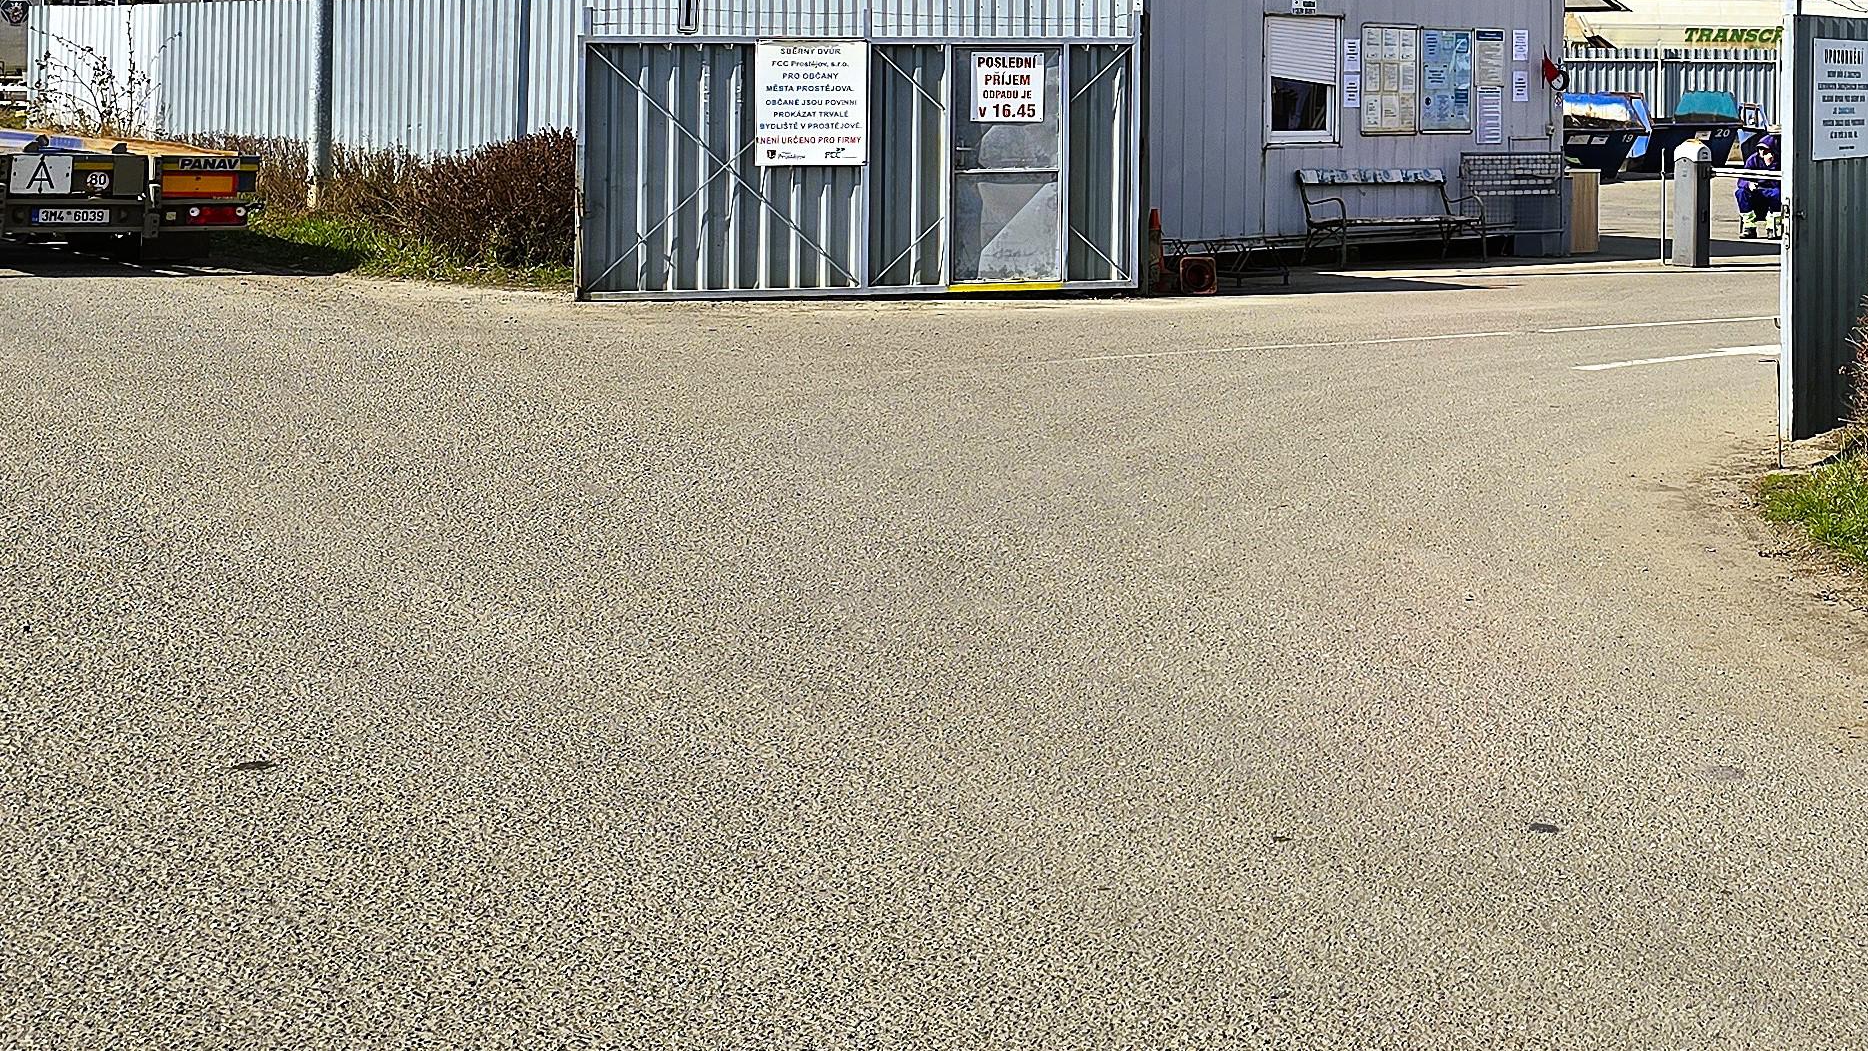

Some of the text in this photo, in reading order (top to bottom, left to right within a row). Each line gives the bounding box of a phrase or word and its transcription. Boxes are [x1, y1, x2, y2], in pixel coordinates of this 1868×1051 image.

[977, 54, 1037, 68] POSLEDNÍ
[802, 71, 839, 80] OBČANY
[984, 71, 1031, 86] PŘÍJEM
[765, 84, 795, 92] MĚSTA
[983, 90, 1032, 99] ODPADU JE
[765, 98, 800, 106] OBČANÉ
[819, 110, 849, 118] TRVALÉ
[993, 103, 1036, 118] 16.45
[759, 122, 798, 130] BYDLIŠTĚ
[1714, 128, 1730, 138] 20
[781, 135, 816, 144] URČENO
[818, 136, 835, 144] PRO
[837, 136, 862, 144] FIRMY
[1622, 134, 1633, 143] 19
[180, 158, 240, 170] PANAV
[25, 156, 55, 190] A
[90, 174, 107, 186] 80
[41, 210, 104, 221] 3M4 6039
